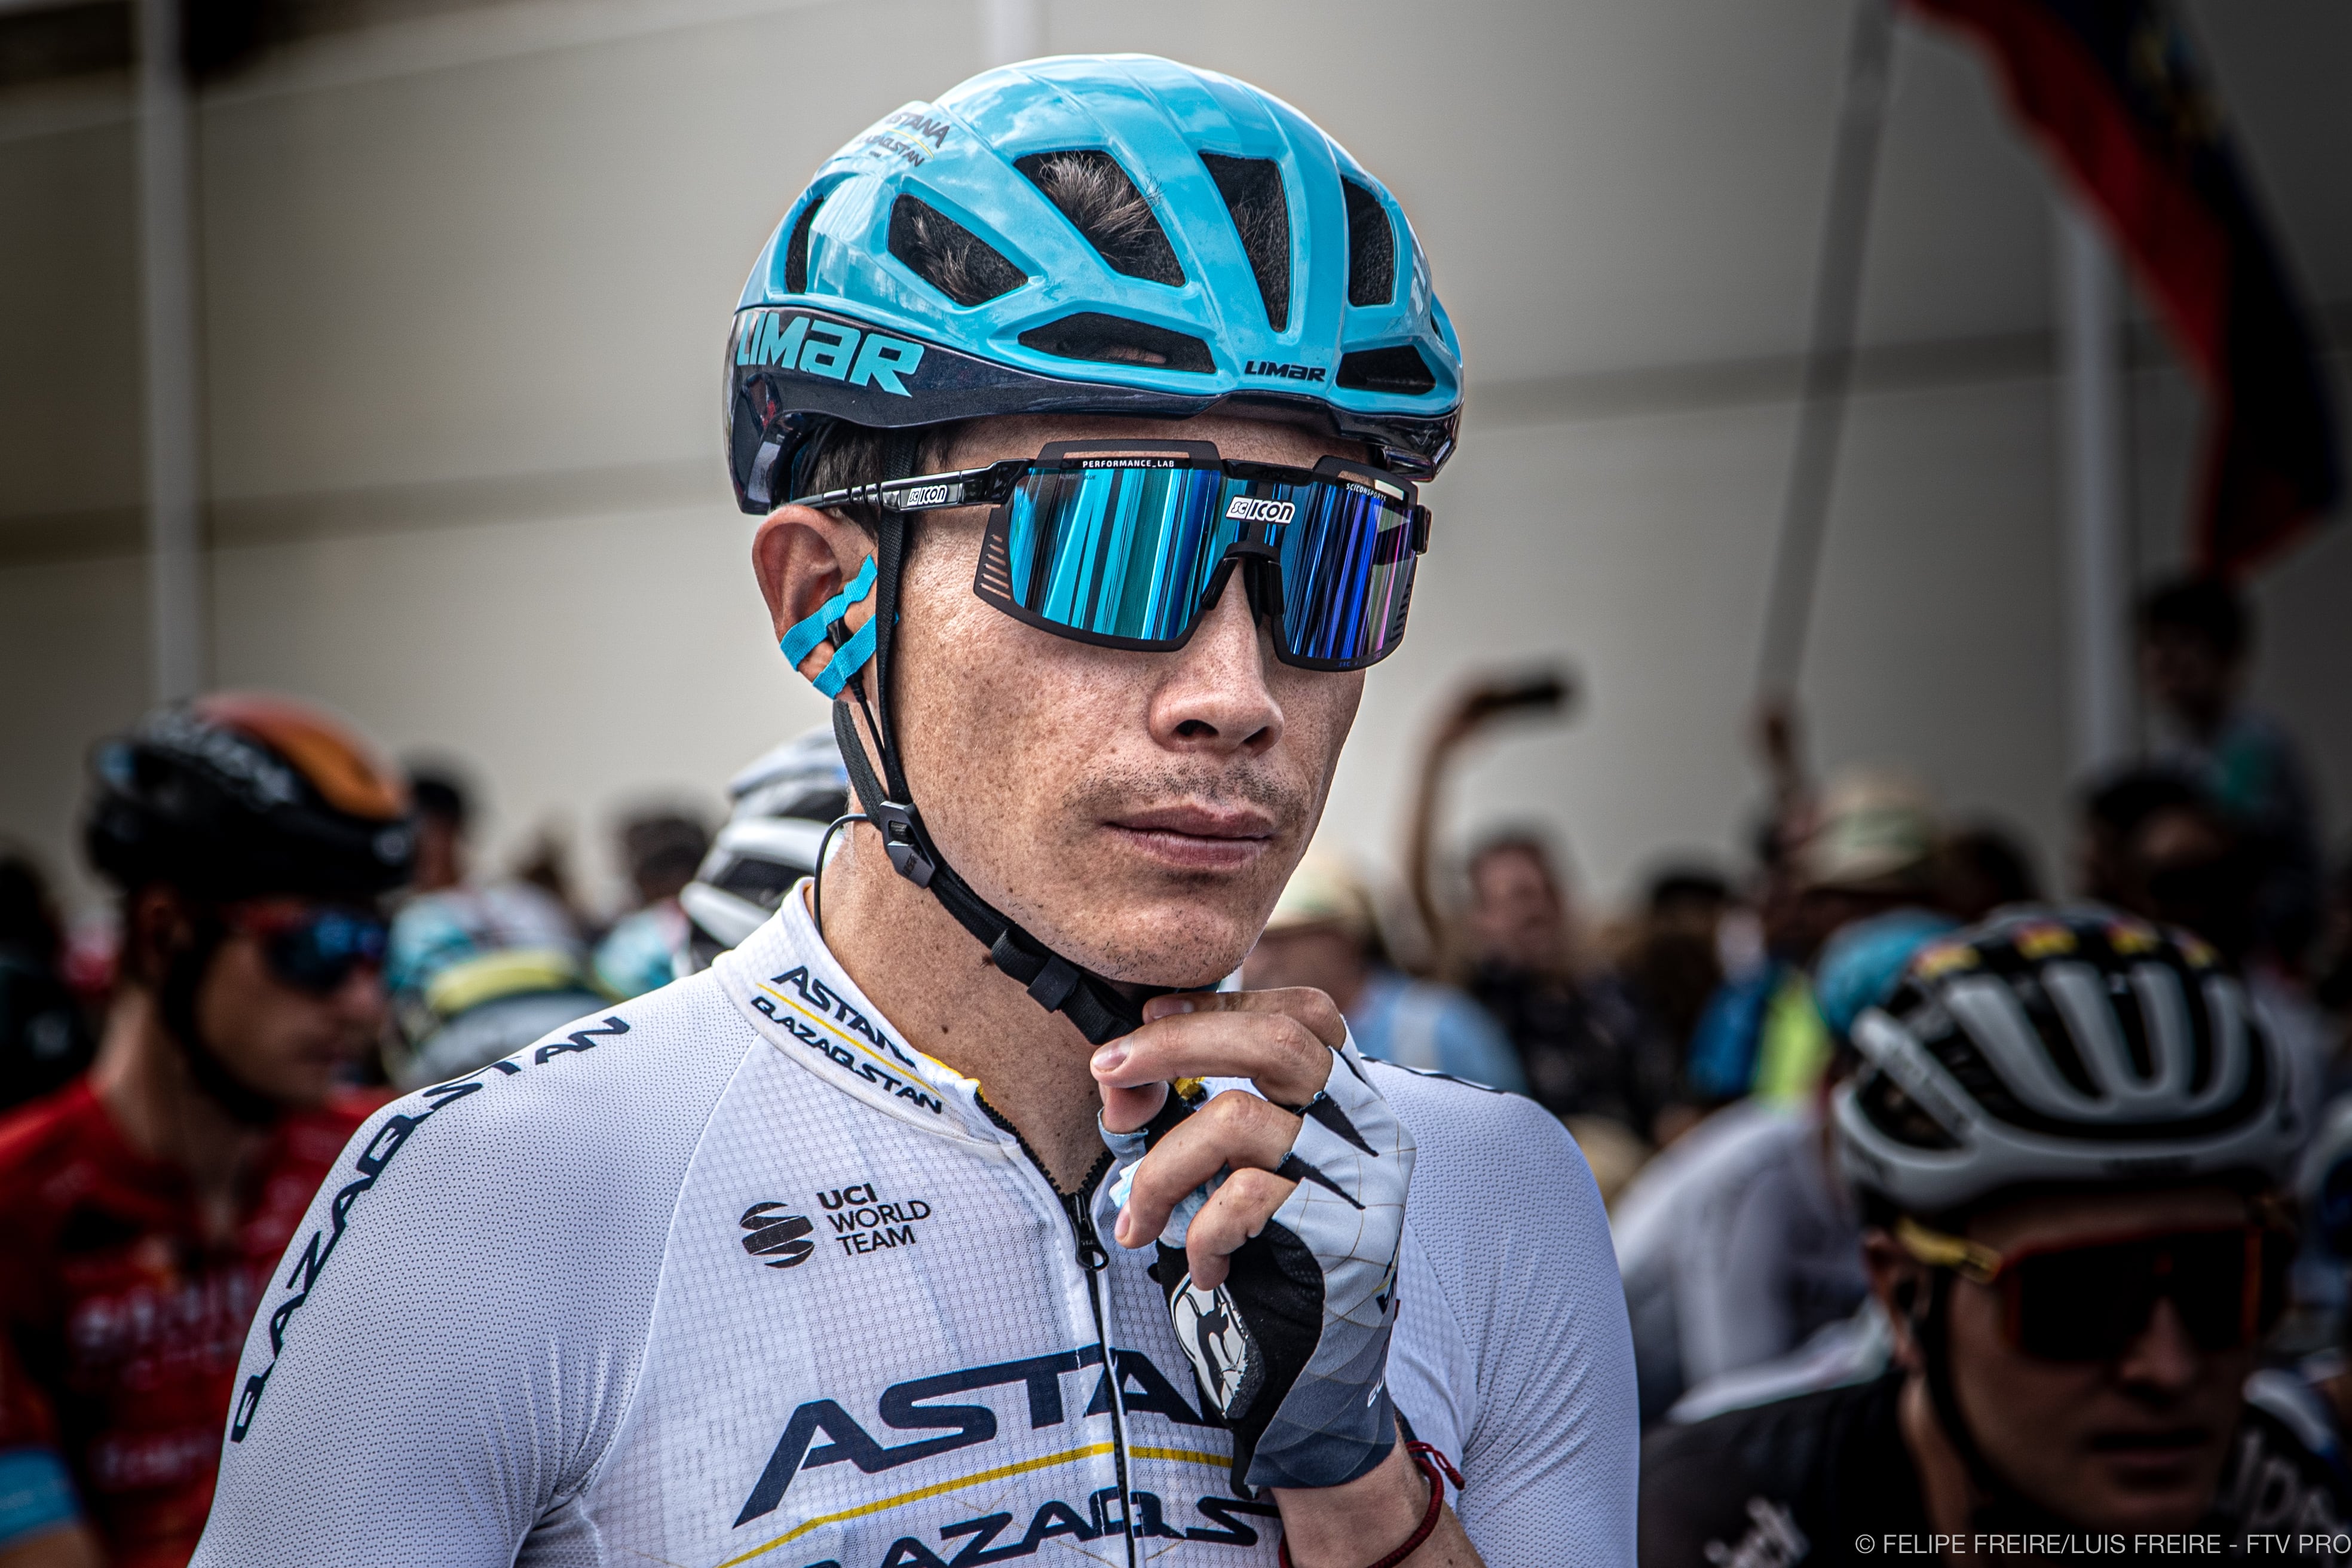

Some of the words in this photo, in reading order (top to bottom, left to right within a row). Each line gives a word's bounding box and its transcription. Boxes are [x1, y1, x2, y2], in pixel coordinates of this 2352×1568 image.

[1082, 459, 1175, 468] PERFORMANCE_LAB
[751, 996, 942, 1114] QAZAQSTAN
[816, 1183, 878, 1210] UCI
[826, 1200, 932, 1233] WORLD
[835, 1225, 916, 1256] TEAM
[733, 1343, 1233, 1529] ASTA
